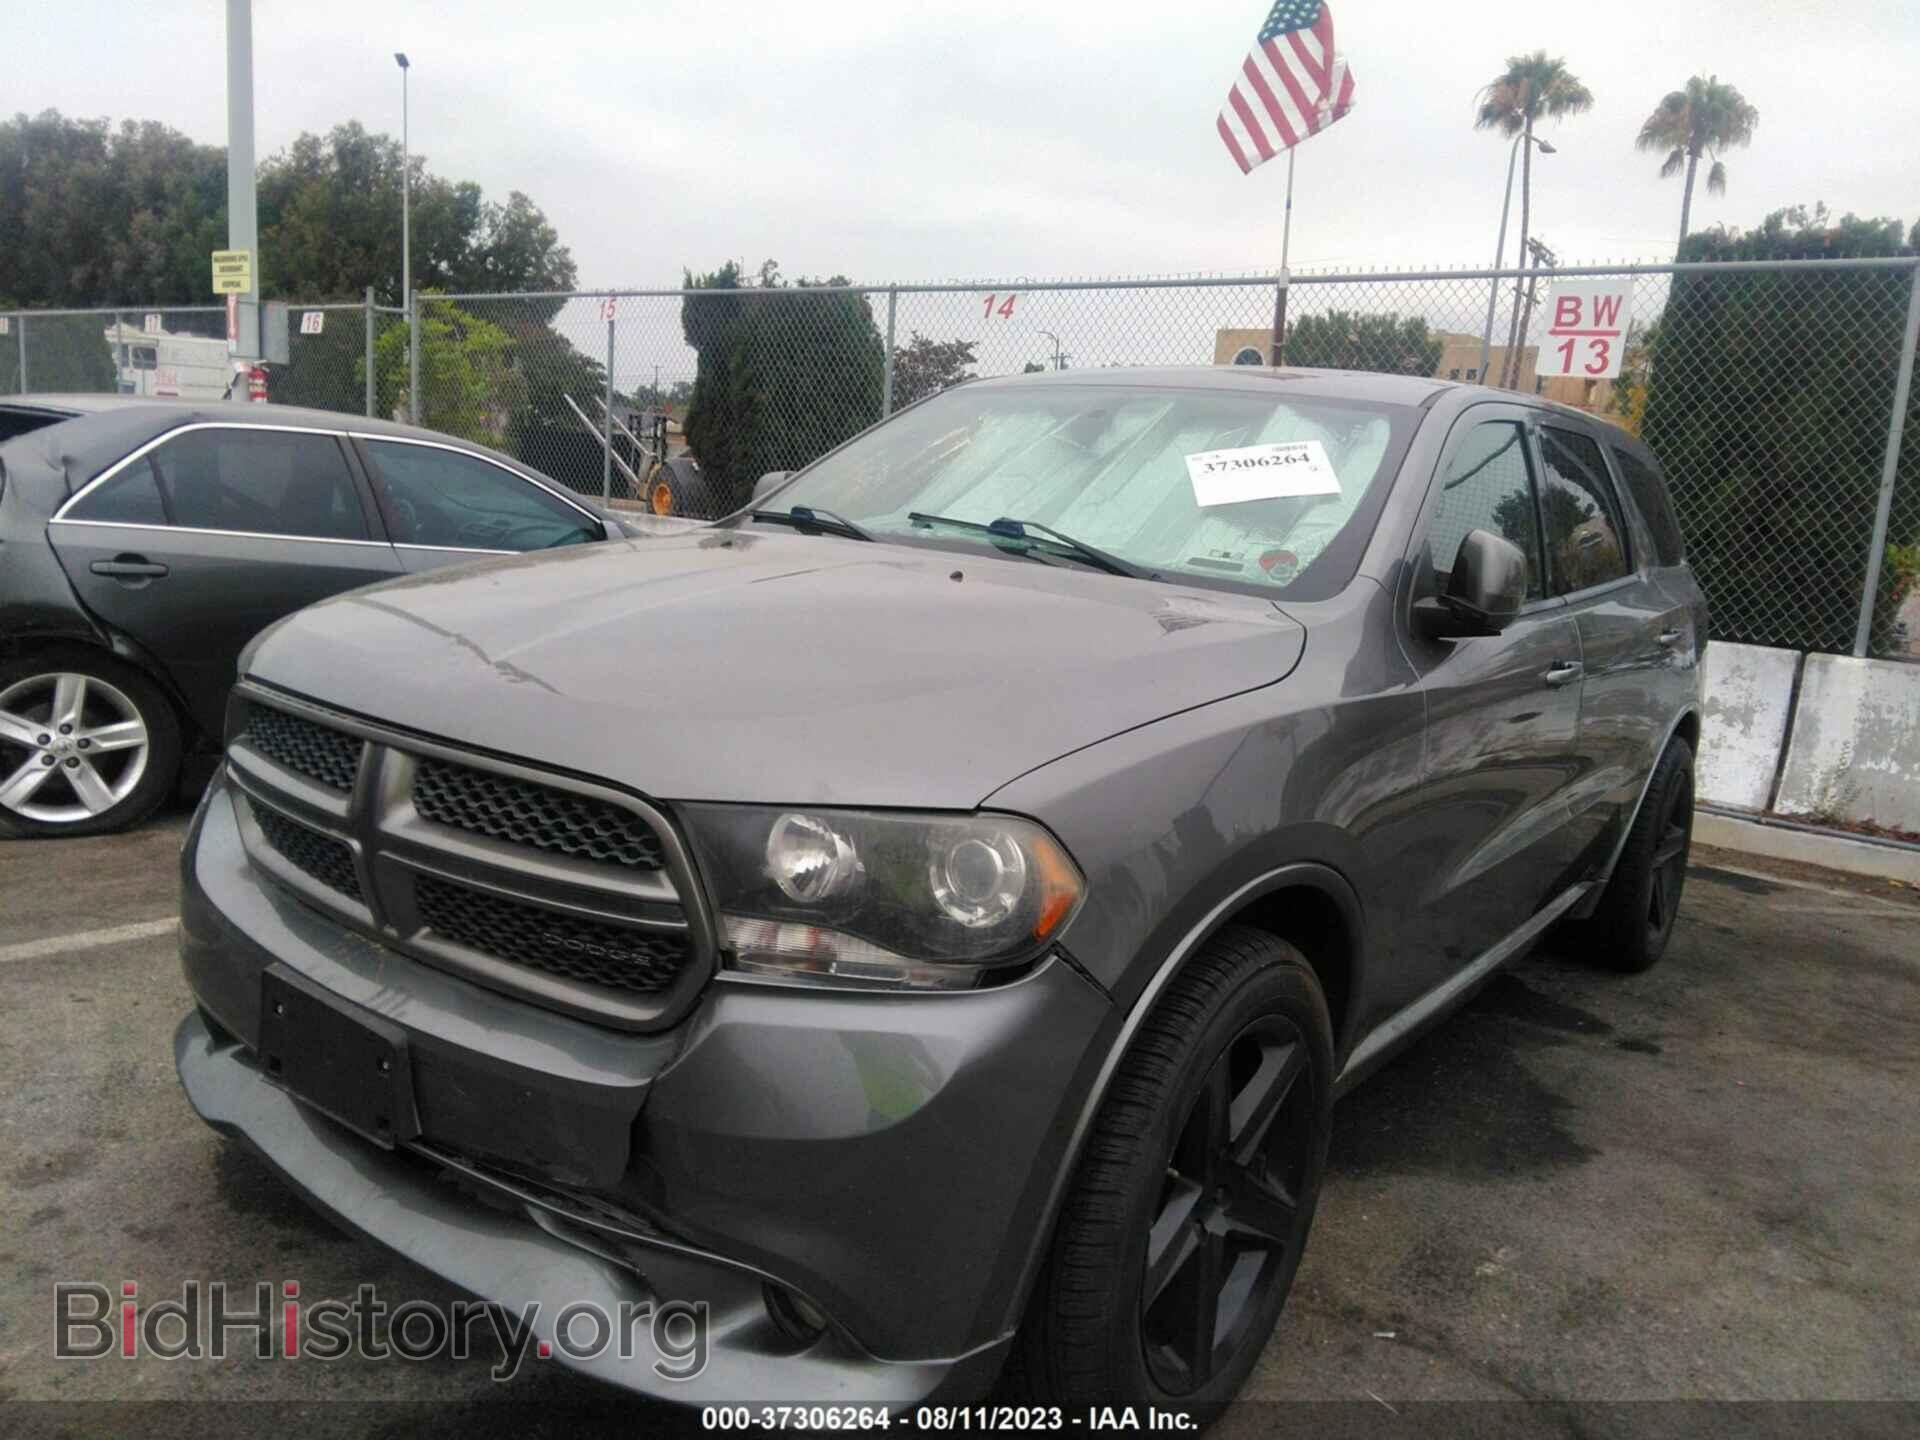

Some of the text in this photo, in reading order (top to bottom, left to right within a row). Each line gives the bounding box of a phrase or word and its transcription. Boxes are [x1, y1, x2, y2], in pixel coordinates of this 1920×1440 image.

[600, 298, 616, 320] 15
[984, 294, 1016, 319] 14
[306, 315, 320, 331] 16
[1558, 338, 1610, 374] 13
[1203, 452, 1310, 473] 37306264
[543, 932, 651, 967] DODGE
